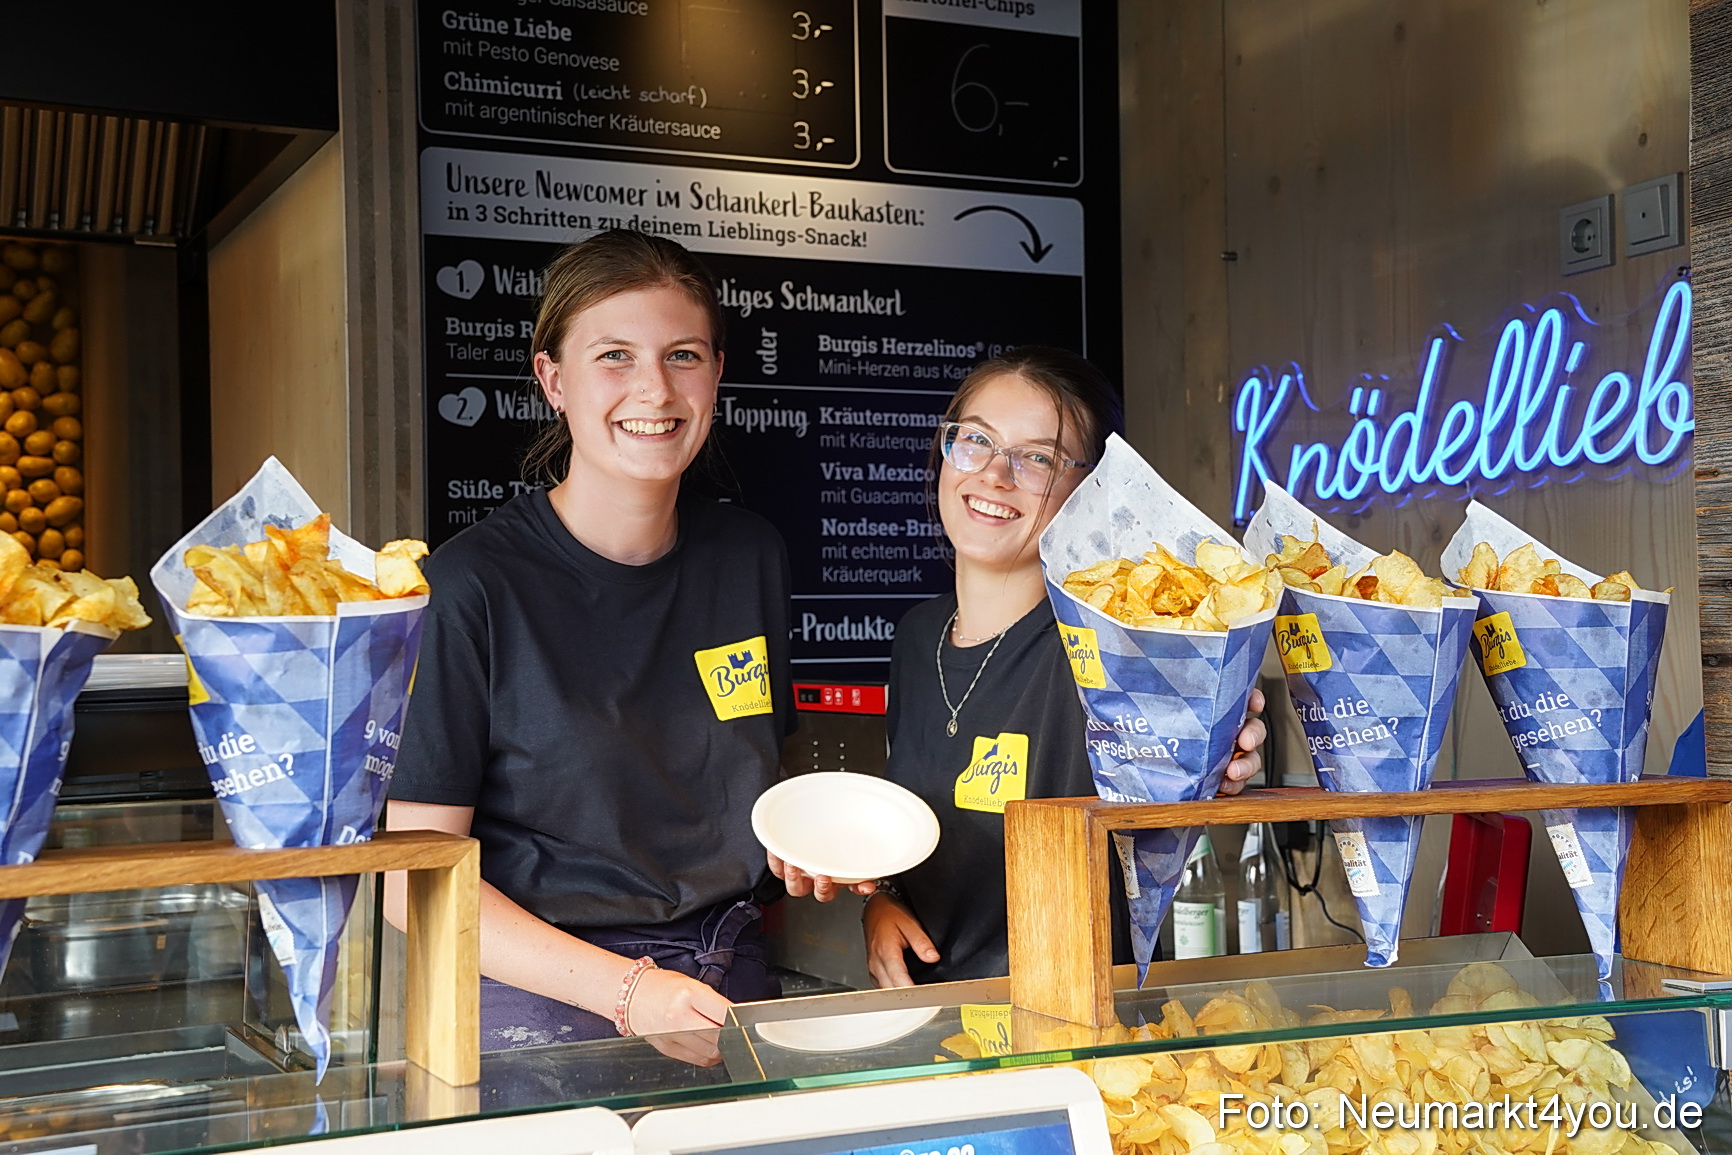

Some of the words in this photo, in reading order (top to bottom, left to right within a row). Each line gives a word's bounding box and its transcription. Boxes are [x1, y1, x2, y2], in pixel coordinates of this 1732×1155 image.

[441, 10, 509, 36] Grüne
[515, 18, 572, 42] Liebe
[792, 11, 833, 40] 3,-
[443, 40, 474, 57] mit
[478, 41, 530, 63] Pesto
[534, 46, 620, 72] Genovese
[443, 71, 563, 100] Chimicurri
[792, 69, 834, 99] 3,-
[445, 100, 474, 118] mit
[479, 102, 604, 130] argentinischer
[609, 114, 722, 140] Kräutersauce
[793, 121, 835, 151] 3,-
[447, 162, 529, 198] Unsere
[536, 170, 648, 207] Newcomer
[690, 181, 925, 227] Schankerl-Baukasten:
[447, 202, 470, 222] in
[475, 204, 488, 223] 3
[494, 206, 592, 230] Schritten
[598, 215, 622, 232] zu
[628, 214, 703, 237] deinem
[708, 220, 868, 248] Lieblings-Snack!
[780, 280, 907, 317] Schmankerl
[445, 316, 515, 342] Burgis
[445, 342, 489, 361] Taler
[493, 348, 525, 362] aus
[756, 326, 778, 375] oder
[818, 334, 877, 358] Burgis
[818, 358, 911, 378] Mini-Herzen
[913, 364, 940, 379] aus
[1235, 280, 1695, 520] Knödellieb
[820, 432, 847, 449] mit
[819, 461, 864, 481] Viva
[868, 463, 936, 483] Mexico
[447, 478, 504, 500] Süße
[820, 487, 848, 504] mit
[850, 487, 937, 506] Guacamole
[448, 506, 478, 524] mit
[821, 544, 848, 560] mit
[851, 543, 909, 560] echtem
[822, 566, 922, 586] Kräuterquark
[789, 612, 896, 642] -Produkte
[1309, 701, 1330, 722] du
[1333, 696, 1370, 719] die
[1508, 700, 1533, 721] du
[1535, 690, 1571, 714] die
[1113, 713, 1149, 734] die
[1308, 716, 1400, 756] gesehen?
[1511, 708, 1603, 754] gesehen?
[217, 731, 257, 760] die
[1089, 737, 1181, 760] gesehen?
